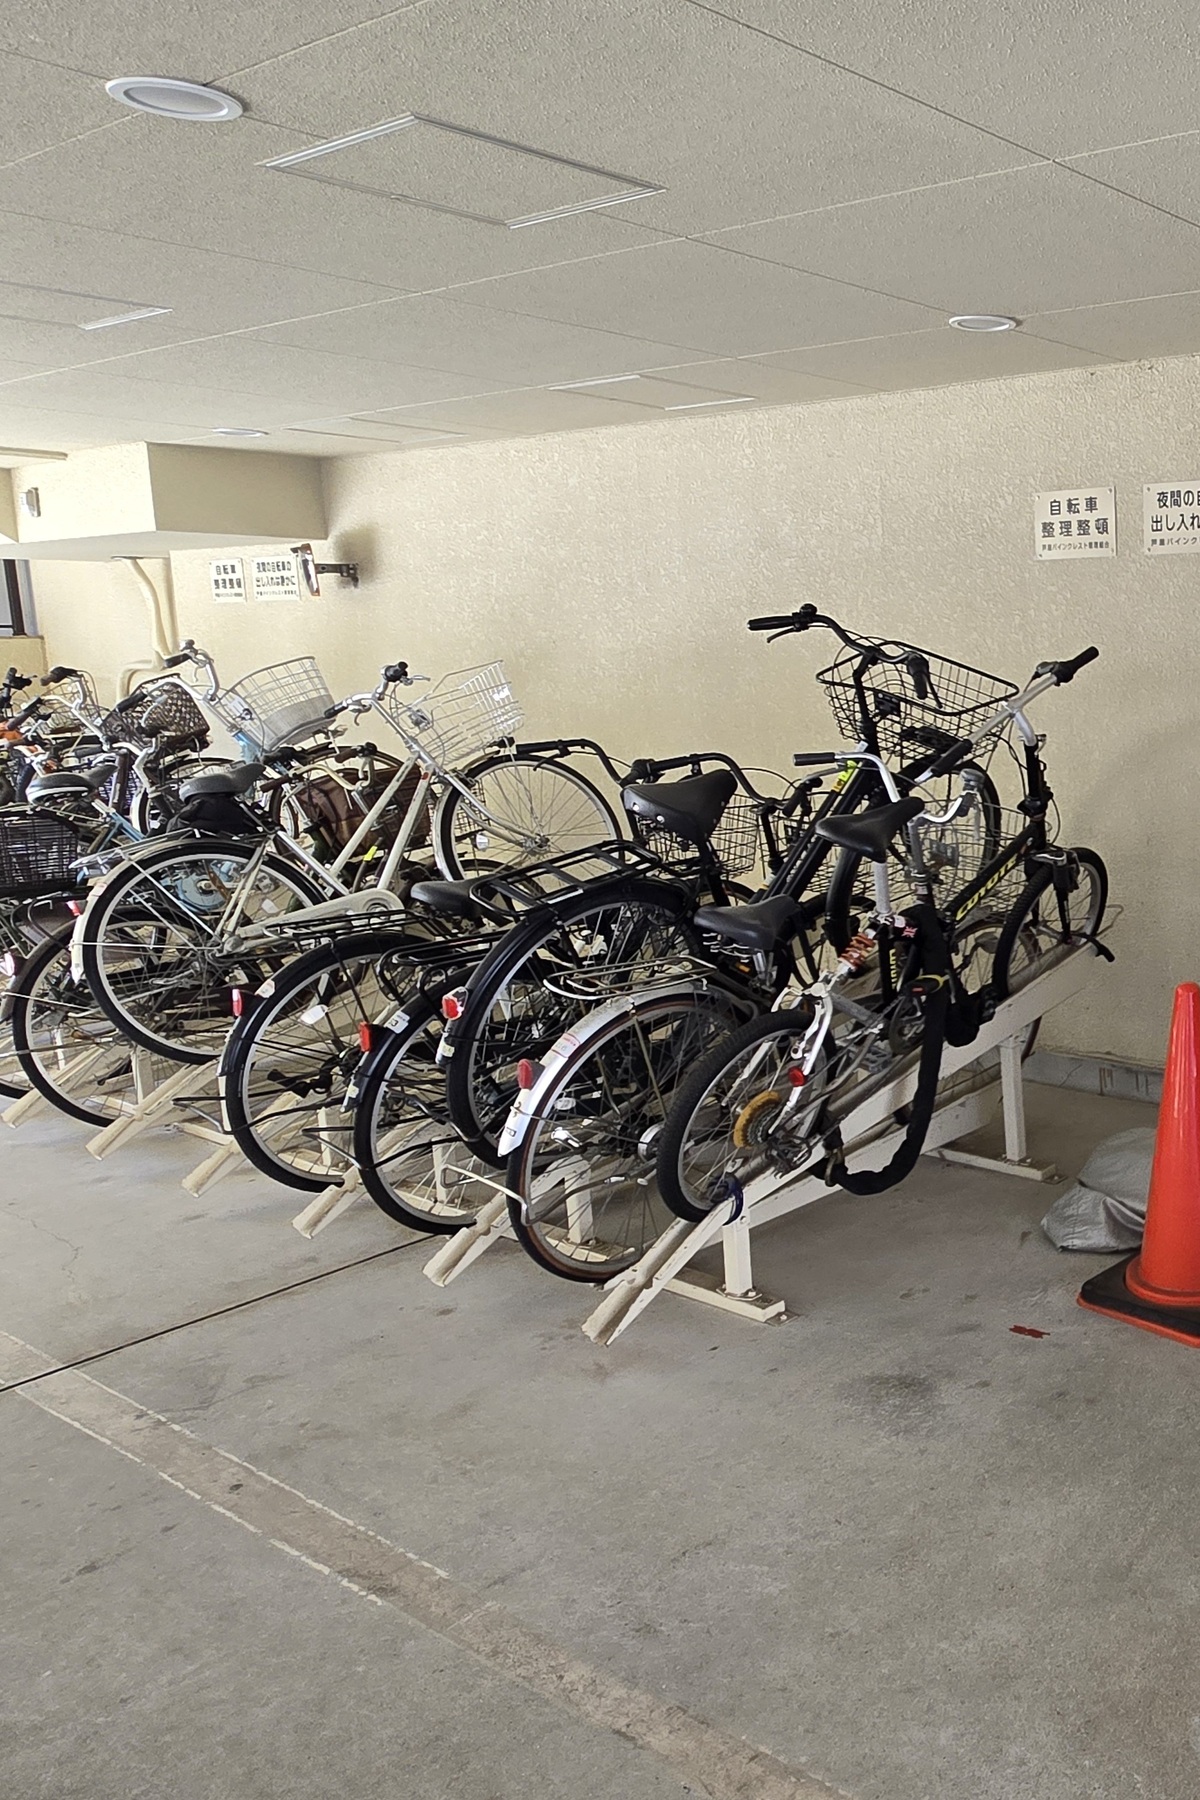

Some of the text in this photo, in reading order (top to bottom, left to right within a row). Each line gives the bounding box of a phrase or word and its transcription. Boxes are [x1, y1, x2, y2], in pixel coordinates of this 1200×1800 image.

[1049, 496, 1099, 516] 自転車
[1041, 517, 1110, 539] 整理整頓
